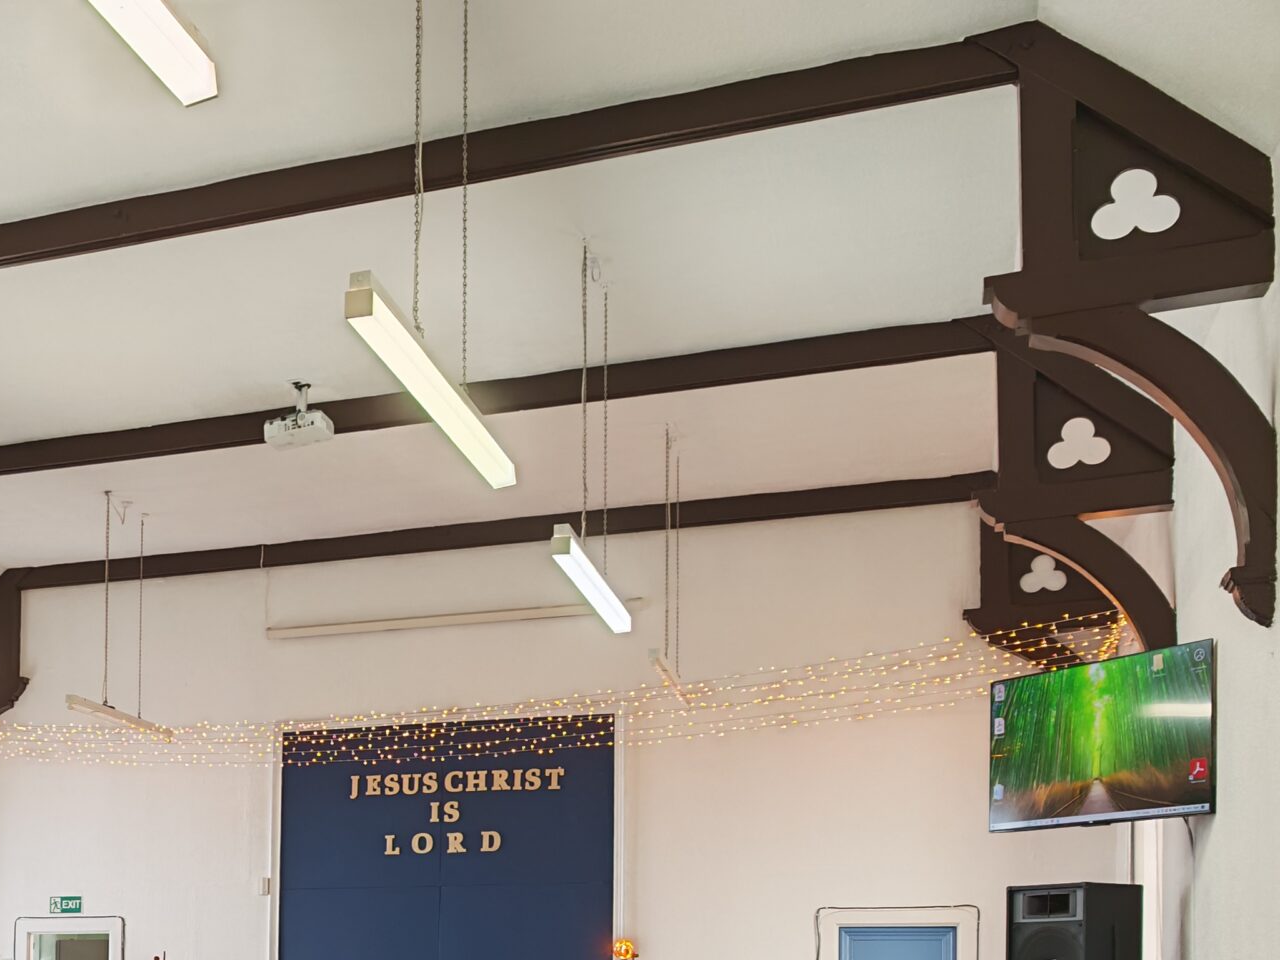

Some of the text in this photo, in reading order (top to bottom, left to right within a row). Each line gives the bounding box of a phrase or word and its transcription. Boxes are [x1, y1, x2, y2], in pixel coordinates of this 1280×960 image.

[349, 767, 565, 799] JESUS CHRIST
[429, 801, 460, 823] IS
[383, 830, 502, 855] LORD
[62, 900, 81, 909] EXIT
